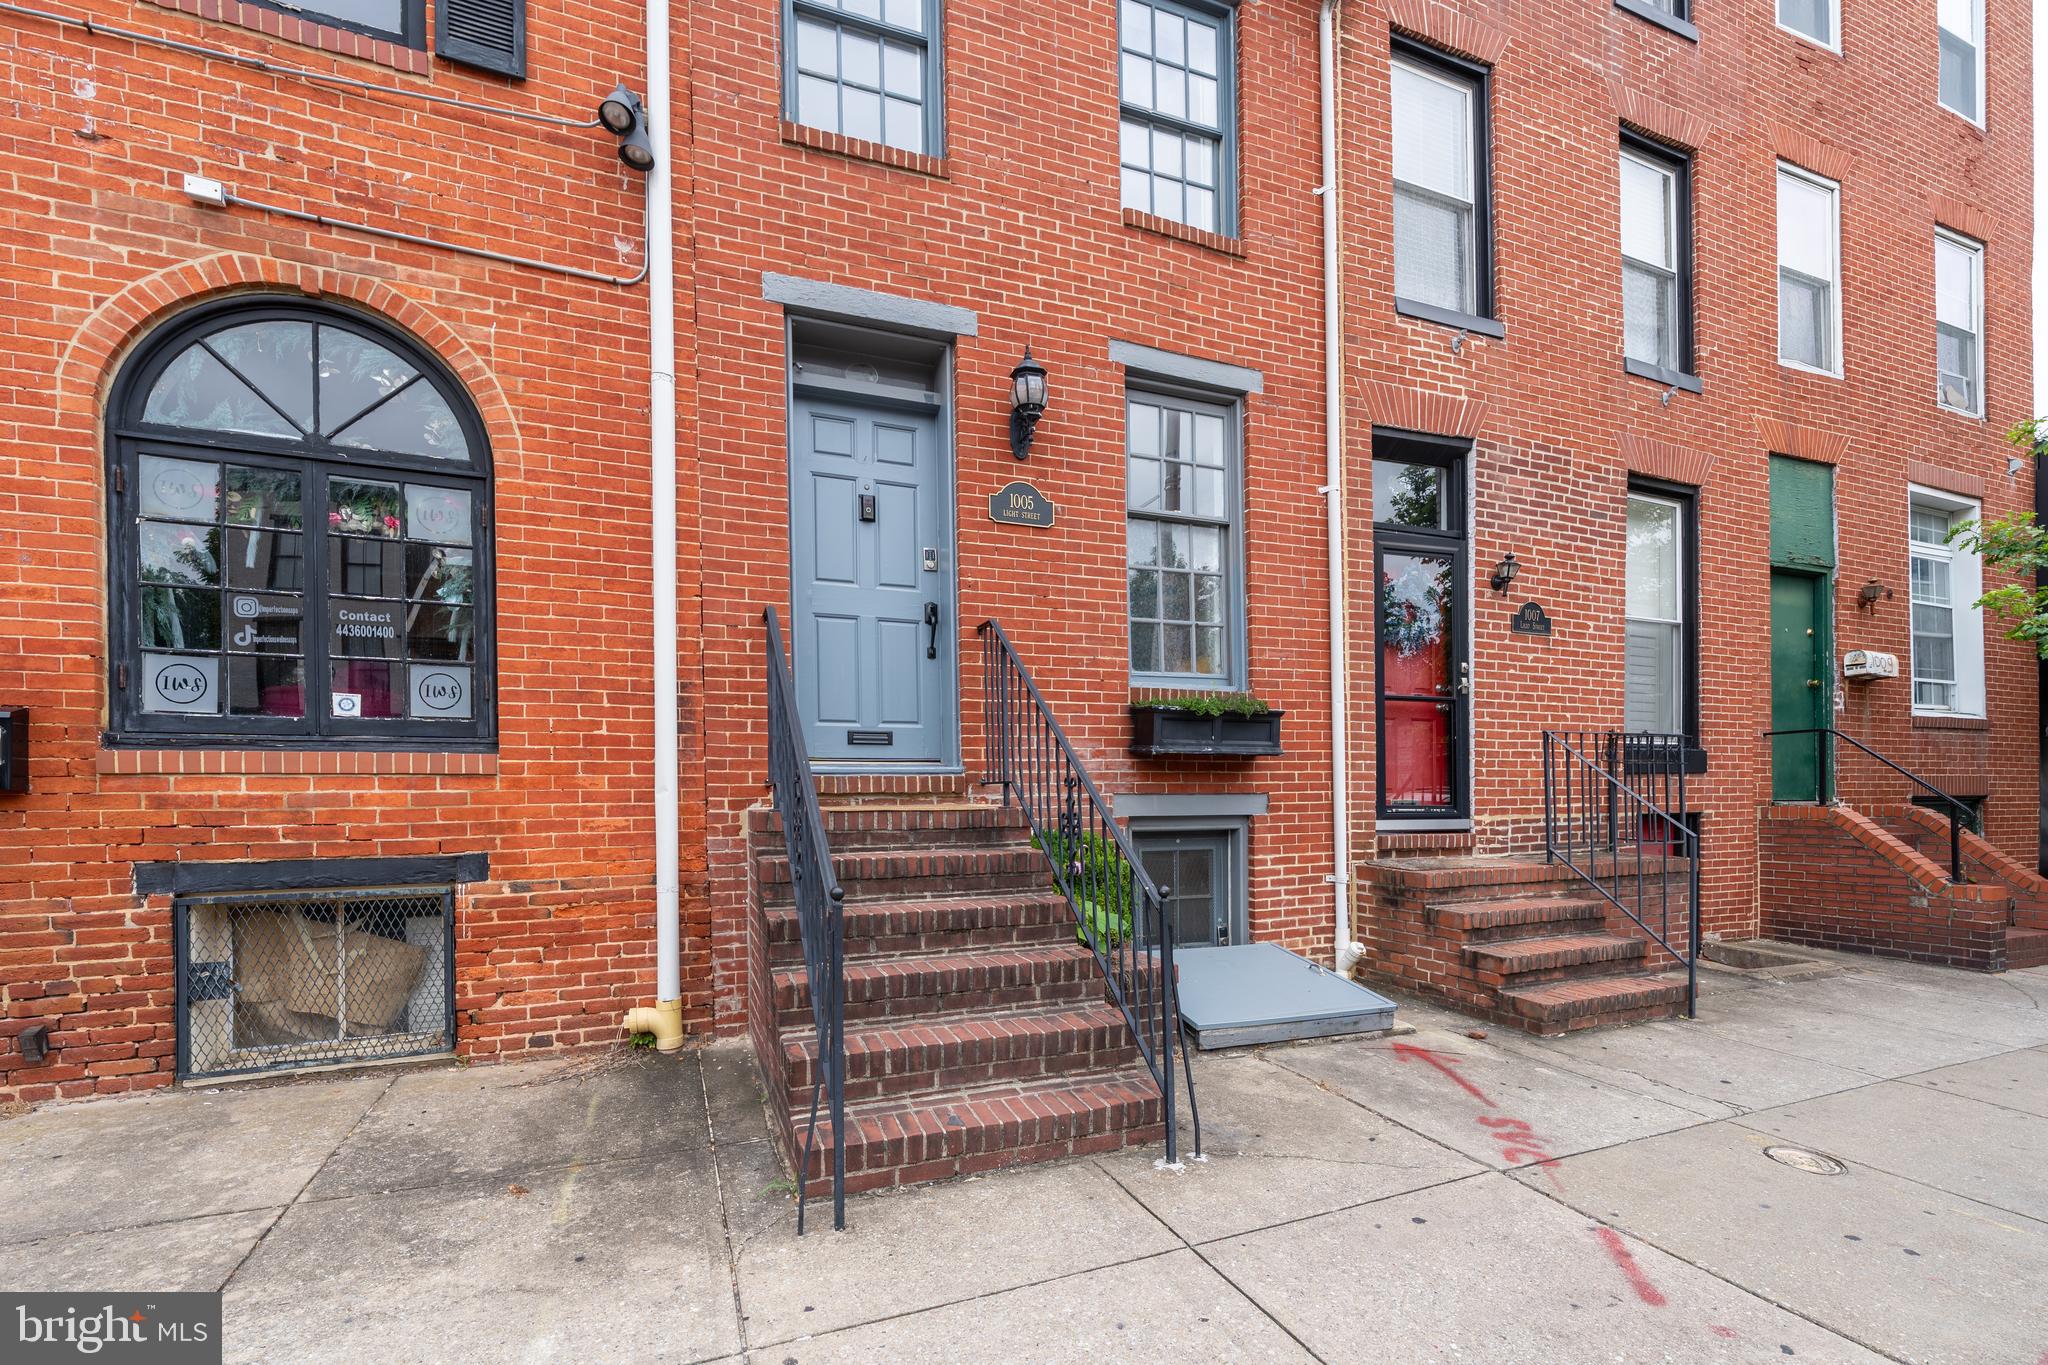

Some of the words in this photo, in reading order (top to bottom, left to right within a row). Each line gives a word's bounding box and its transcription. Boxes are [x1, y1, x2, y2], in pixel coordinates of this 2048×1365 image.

[1009, 493, 1034, 510] 1005
[1003, 509, 1019, 518] LIGHT
[1021, 511, 1041, 520] STREET
[339, 609, 391, 623] Contact
[1524, 608, 1541, 622] 1007
[336, 623, 395, 639] 4436001400
